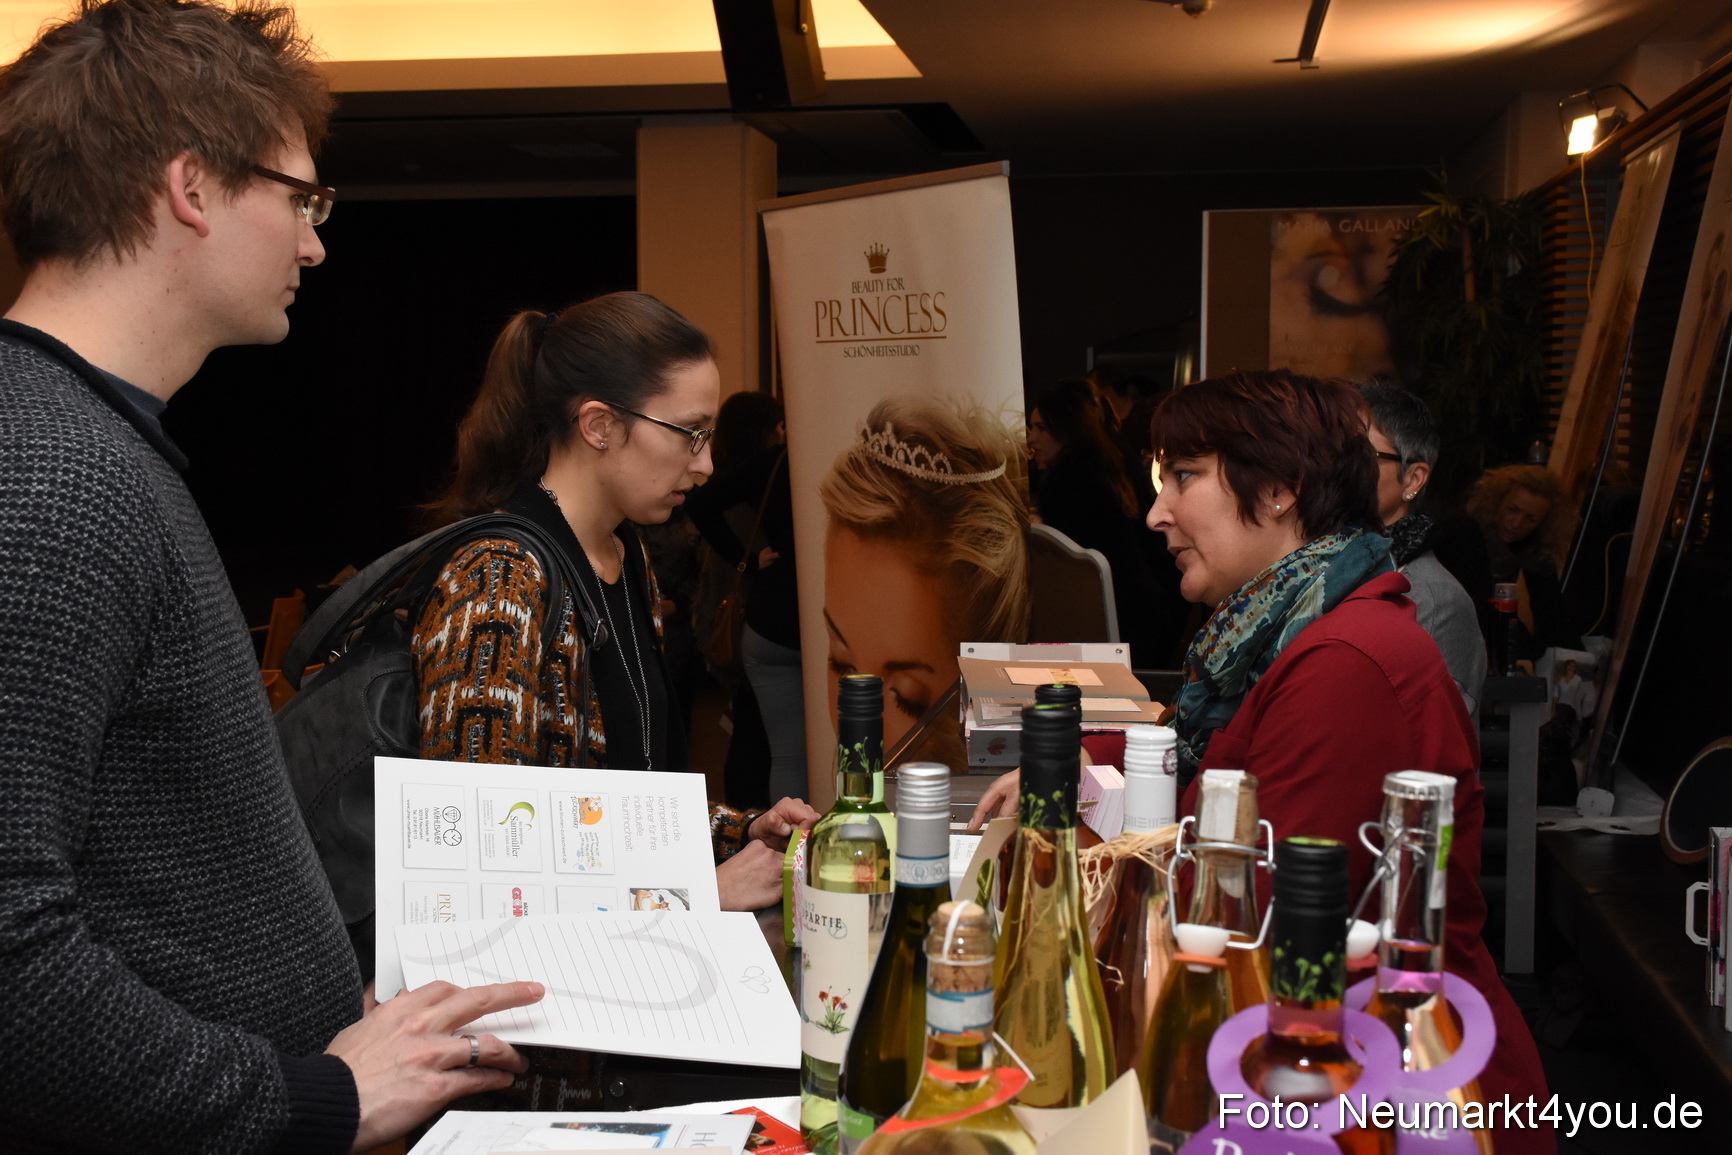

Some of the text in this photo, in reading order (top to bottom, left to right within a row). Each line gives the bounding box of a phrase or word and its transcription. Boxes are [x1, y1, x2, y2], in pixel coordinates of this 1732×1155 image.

[1277, 219, 1332, 233] MARIA
[851, 277, 905, 294] BEAUTY FOR
[814, 291, 947, 338] PRINCESS
[842, 344, 920, 358] SCHÖNHEITSSTUDIO
[433, 806, 442, 846] MÜHLBAUER
[510, 815, 520, 858] Sammüller
[633, 795, 644, 837] individuelle
[645, 795, 658, 851] Partner für Ihre
[657, 796, 669, 847] kompetenten
[670, 796, 682, 841] Wir sind die
